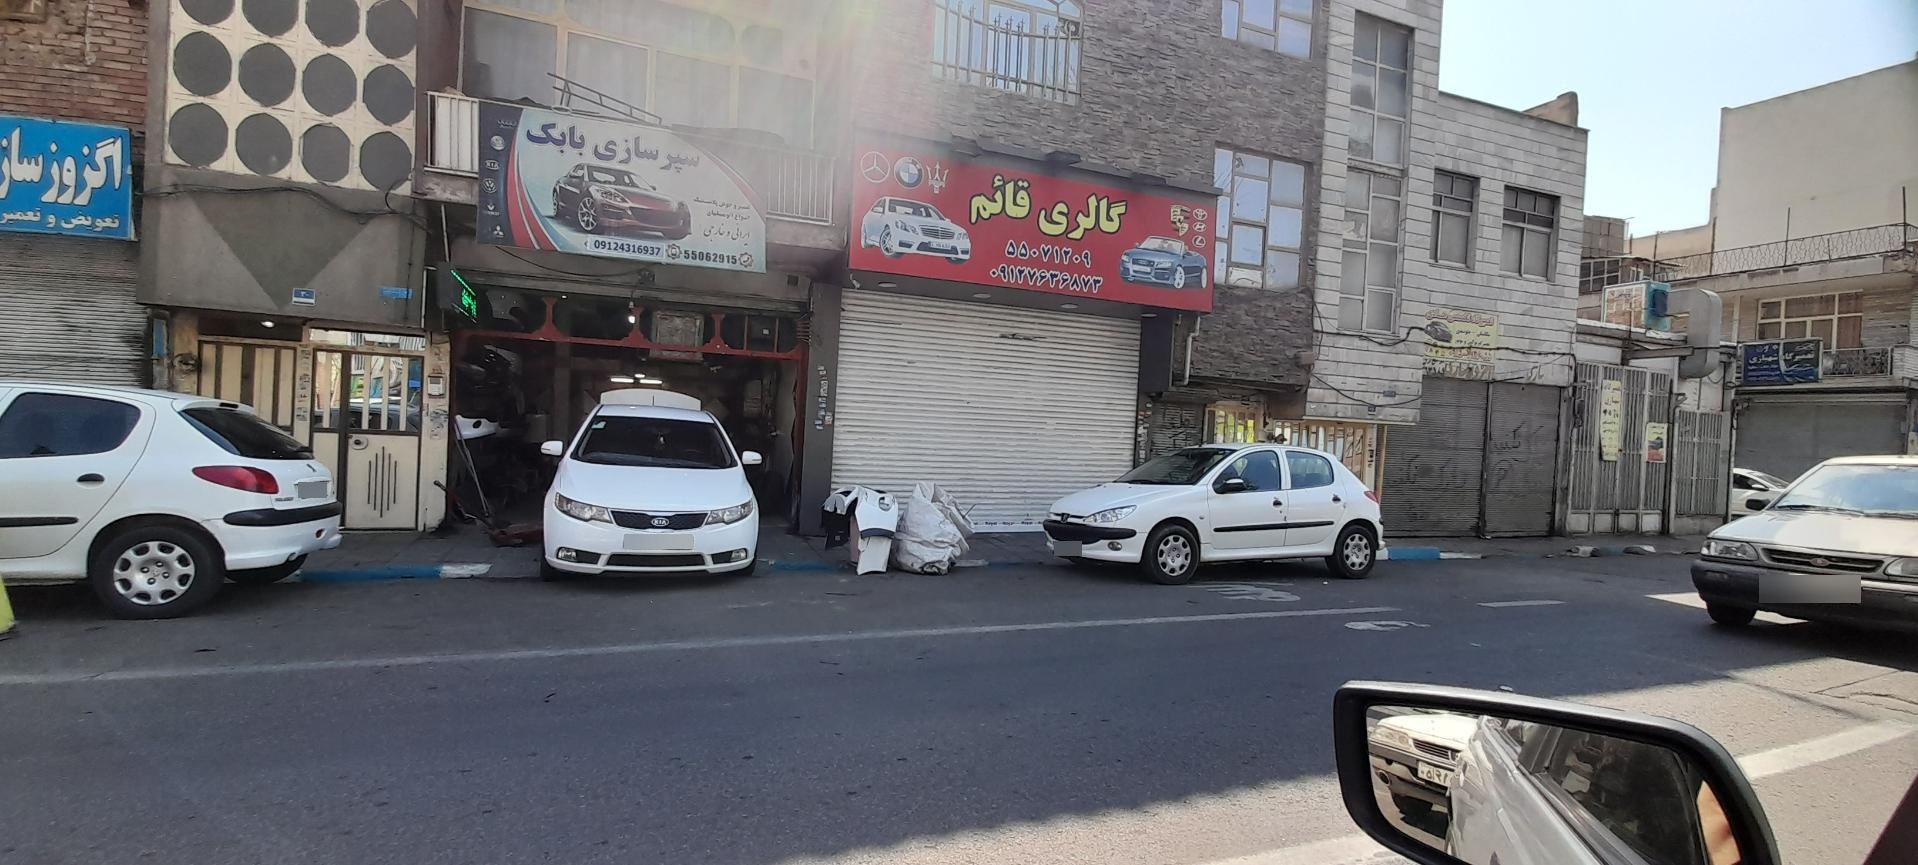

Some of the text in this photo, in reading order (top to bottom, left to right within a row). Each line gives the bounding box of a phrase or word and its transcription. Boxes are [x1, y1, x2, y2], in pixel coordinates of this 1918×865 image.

[526, 122, 700, 173] سپر سازی بابک
[40, 136, 122, 205] اگزوز
[969, 174, 1127, 240] گالری قائم
[46, 214, 56, 228] و
[61, 211, 120, 232] تعویض
[703, 223, 725, 242] خارجی
[730, 221, 750, 246] ایرانی
[594, 239, 737, 265] 09124316937 55062915
[1005, 239, 1091, 268] ۵۵۰۷۱۲۰۹
[989, 263, 1103, 294] ۰۹۱۲۷۶۳۶۸۷۳
[653, 519, 668, 527] KIA
